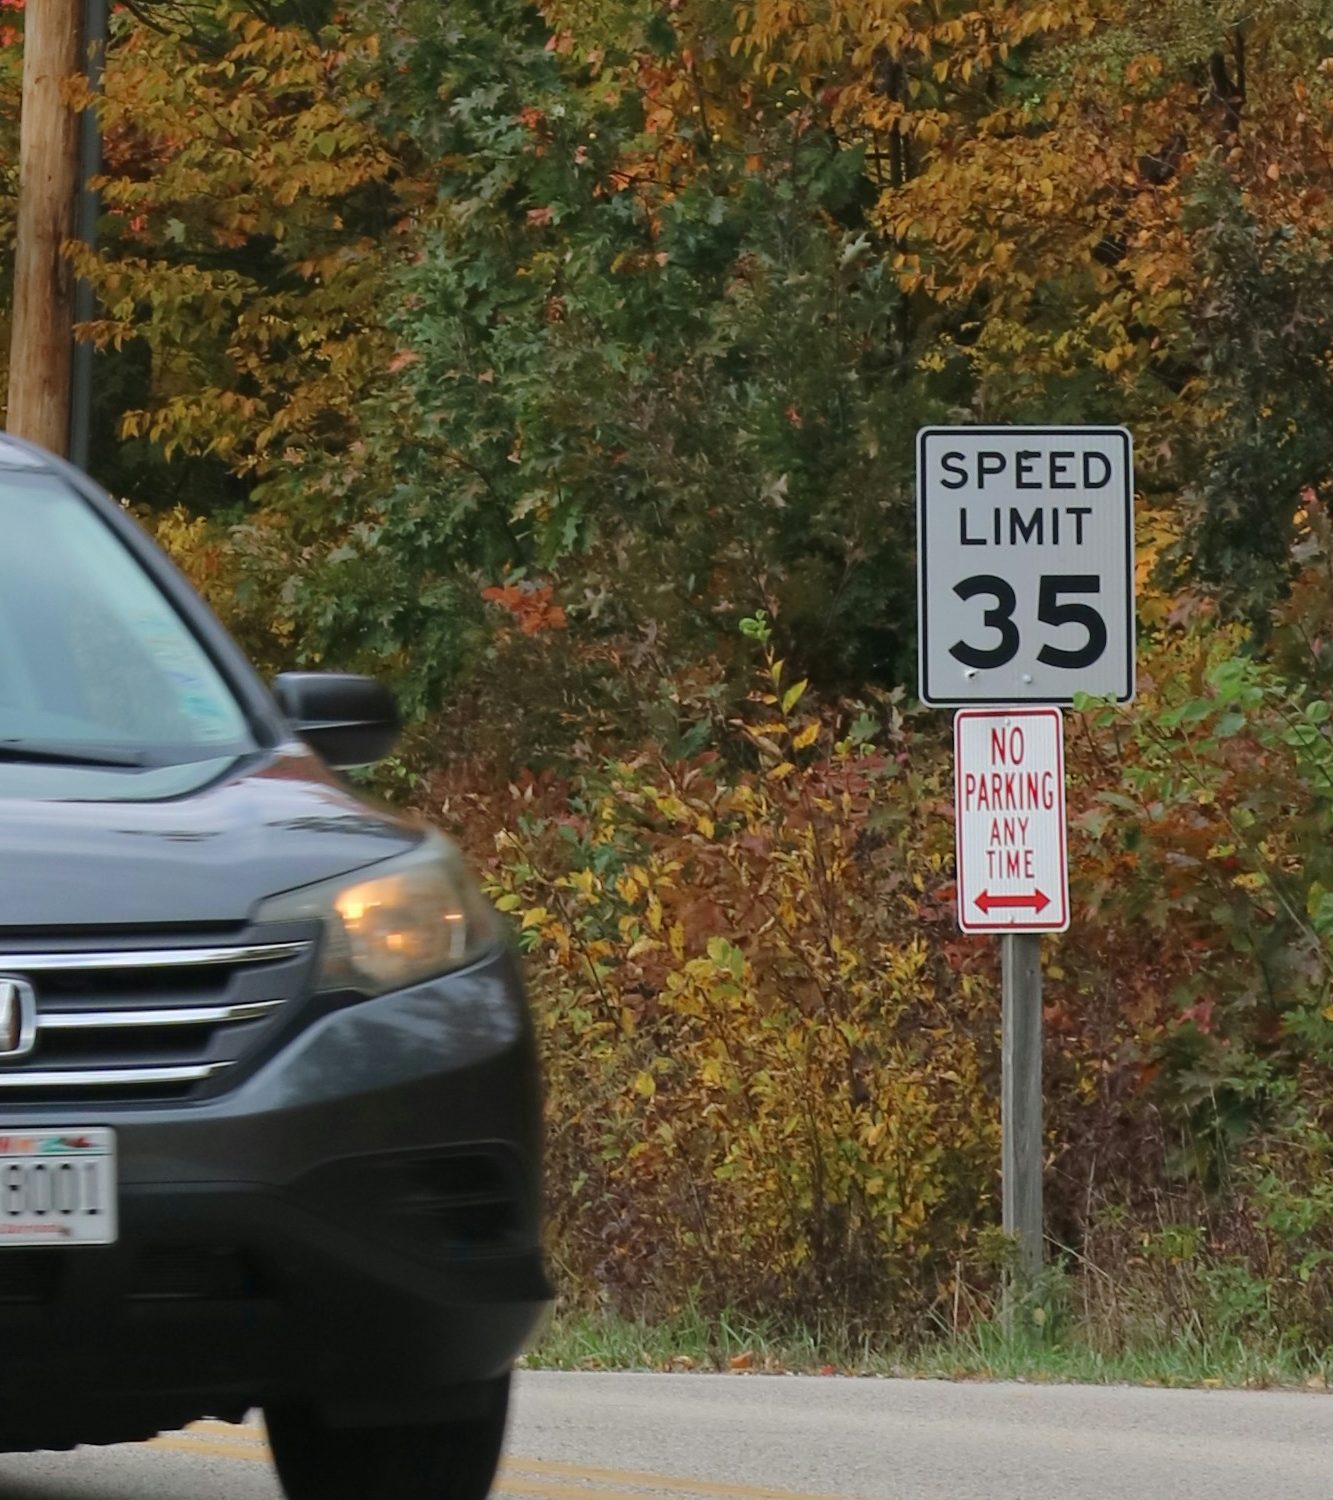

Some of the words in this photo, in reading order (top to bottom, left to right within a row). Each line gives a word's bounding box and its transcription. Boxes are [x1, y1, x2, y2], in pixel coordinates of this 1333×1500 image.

[940, 451, 1112, 489] SPEED
[960, 507, 1092, 546] LIMIT
[948, 574, 1108, 669] 35
[991, 727, 1025, 766] NO
[965, 771, 1054, 811] PARKING
[989, 816, 1030, 847] ANY
[986, 850, 1035, 880] TIME
